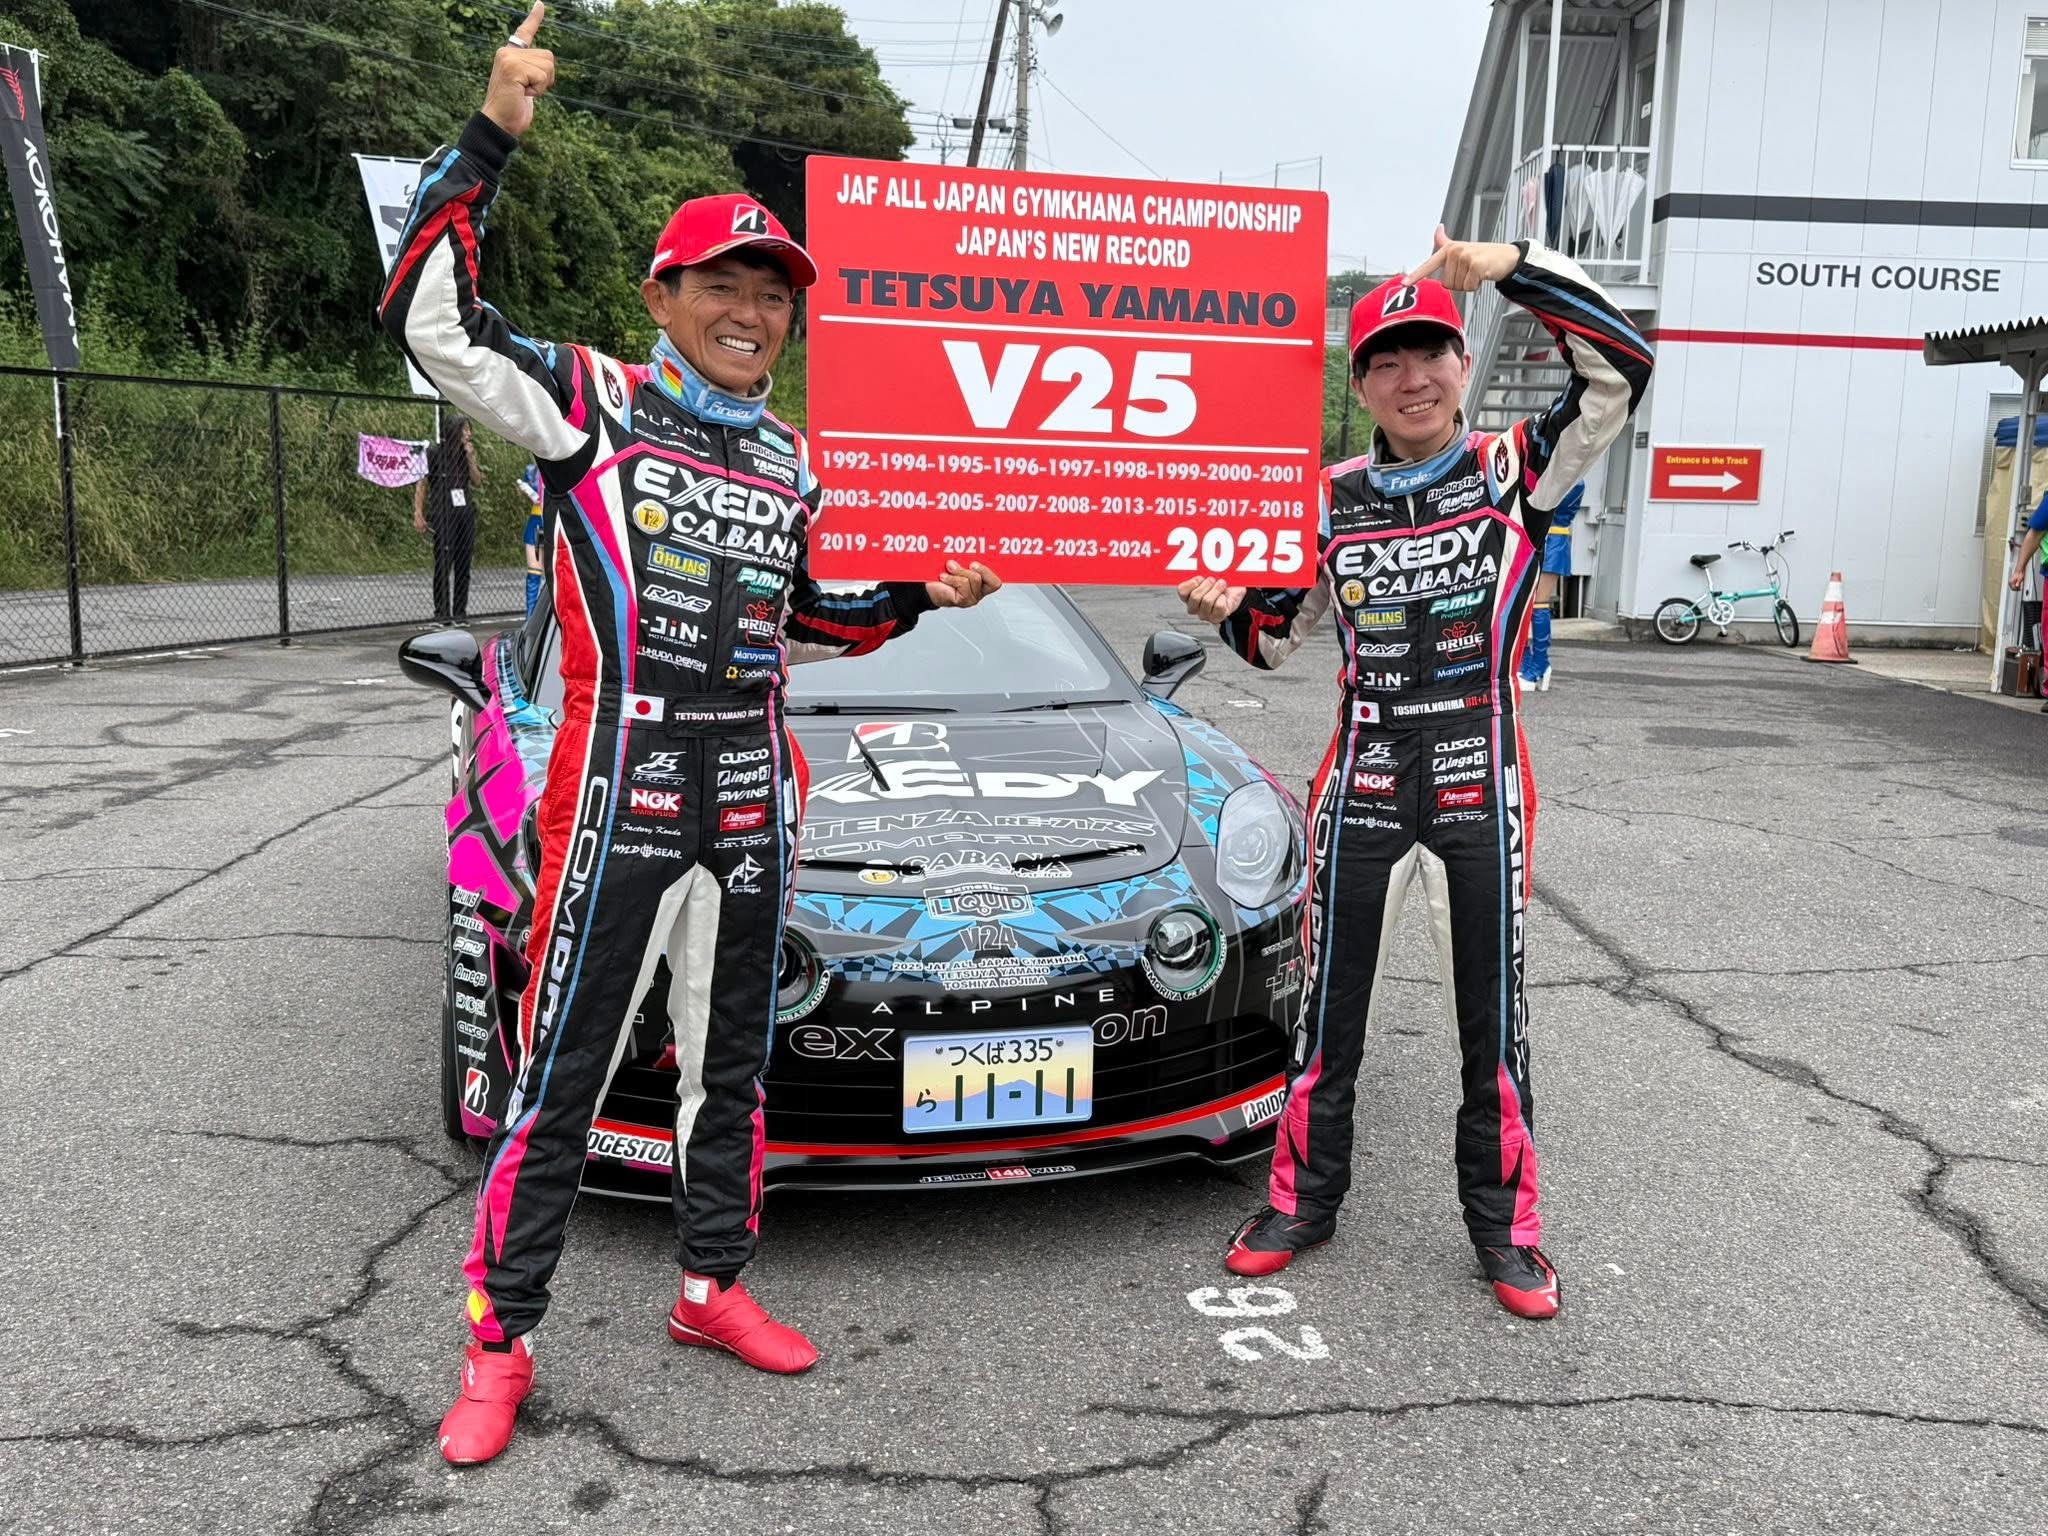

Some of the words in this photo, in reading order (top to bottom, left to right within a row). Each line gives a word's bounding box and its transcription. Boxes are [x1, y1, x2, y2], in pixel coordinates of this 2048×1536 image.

[836, 173, 879, 205] JAF
[885, 177, 927, 209] ALL
[933, 181, 1005, 215] JAPAN
[1012, 186, 1136, 224] GYMKHANA
[1142, 195, 1302, 233] CHAMPIONSHIP
[956, 225, 1046, 261] JAPAN'S
[1053, 231, 1100, 263] NEW
[1106, 235, 1190, 268] RECORD
[1756, 262, 1861, 288] SOUTH
[1871, 265, 2001, 292] COURSE
[838, 267, 1064, 317] TETSUYA
[1079, 282, 1297, 328] YAMANO
[942, 340, 1197, 437] V25
[1666, 455, 1700, 464] Entrance
[1702, 456, 1710, 464] to
[1712, 456, 1724, 464] the
[1726, 456, 1748, 465] Track
[634, 457, 800, 533] EXEDY
[1331, 501, 1394, 516] ALPINE
[672, 511, 798, 563] CABANA
[1165, 526, 1304, 573] 2025
[1336, 518, 1492, 578] EXEDY
[1368, 554, 1497, 596] CABANA
[644, 585, 711, 611] RAYS
[738, 617, 776, 634] BRIDE
[1357, 643, 1411, 657] RAYS
[1436, 633, 1485, 651] BRIDE
[733, 650, 776, 662] Maruyama
[1437, 662, 1484, 678] Maruyama
[674, 712, 715, 720] TETSUYA
[716, 710, 747, 720] YAMANO
[1434, 737, 1486, 753] CUSCO
[719, 748, 769, 764] CUSCO
[1354, 772, 1395, 790] NGK
[1433, 769, 1487, 785] SWANS
[630, 788, 682, 812] NGK
[716, 785, 770, 802] SWANS
[621, 822, 653, 834] Factory
[934, 893, 1026, 914] LIQUID
[454, 914, 483, 932] BRIDE
[959, 924, 1018, 952] V24
[892, 962, 923, 971] 2025
[926, 962, 949, 971] JAF
[952, 960, 976, 970] ALL
[979, 958, 1020, 968] JAPAN
[1022, 953, 1087, 965] GYMKHANA
[938, 969, 998, 980] TETSUYA
[1000, 967, 1050, 977] YAMANO
[943, 980, 999, 990] TOSHIYA
[1000, 977, 1048, 988] NOJIMA
[871, 988, 1115, 1016] ALPINE
[457, 1020, 488, 1040] CUSCO
[955, 1067, 1075, 1122] 11-11
[991, 1167, 1025, 1179] 146
